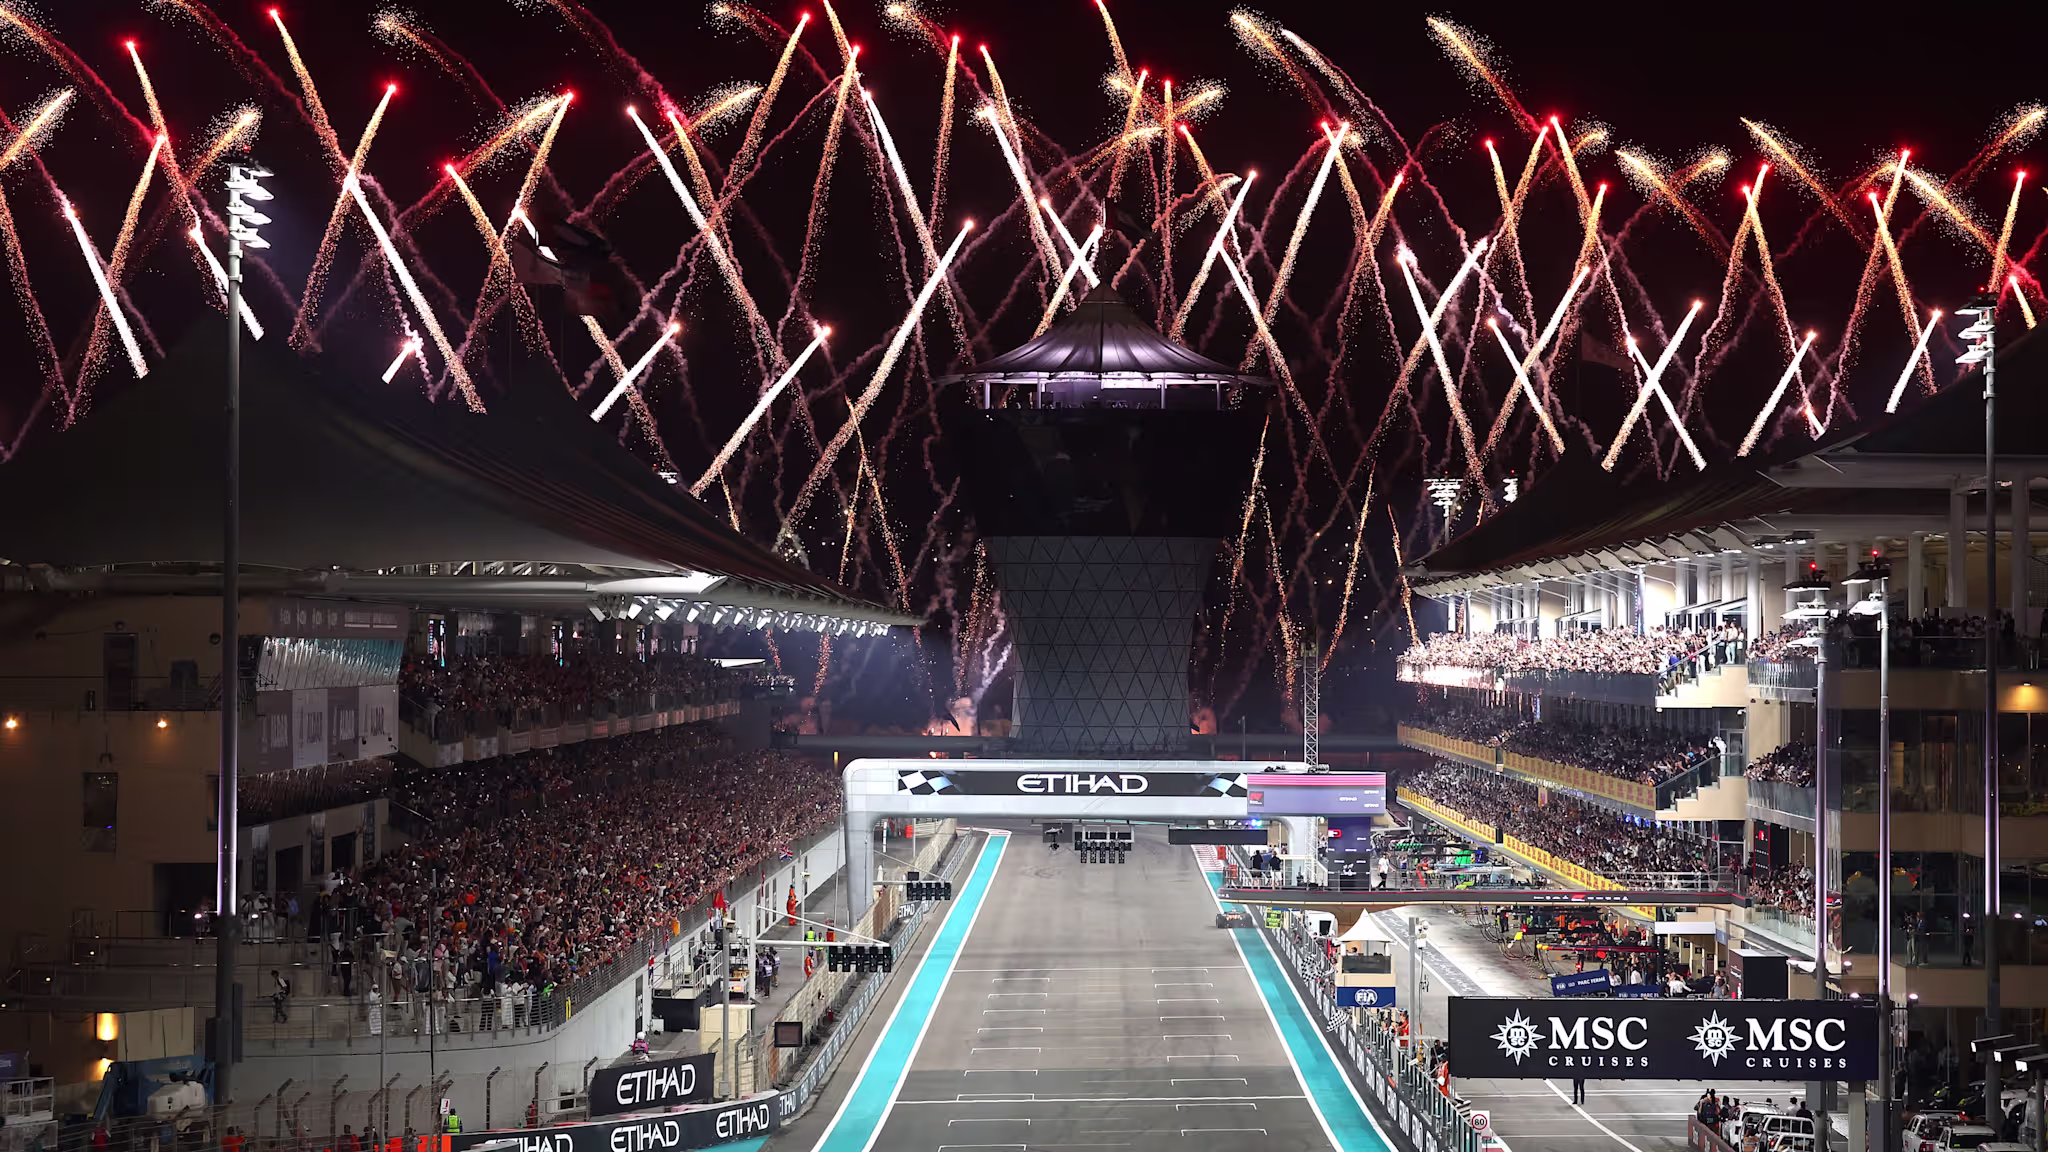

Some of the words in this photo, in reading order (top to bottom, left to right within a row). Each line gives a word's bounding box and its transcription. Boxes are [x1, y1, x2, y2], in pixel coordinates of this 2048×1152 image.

[1017, 774, 1149, 793] ETIHAD
[1548, 1017, 1648, 1051] MSC
[1745, 1018, 1846, 1052] MSC
[1548, 1056, 1649, 1067] CRUISES
[1745, 1057, 1847, 1069] CRUISES
[616, 1064, 696, 1105] ETIHAD
[610, 1121, 680, 1152] ETIHAD
[716, 1103, 770, 1138] ETIHAD
